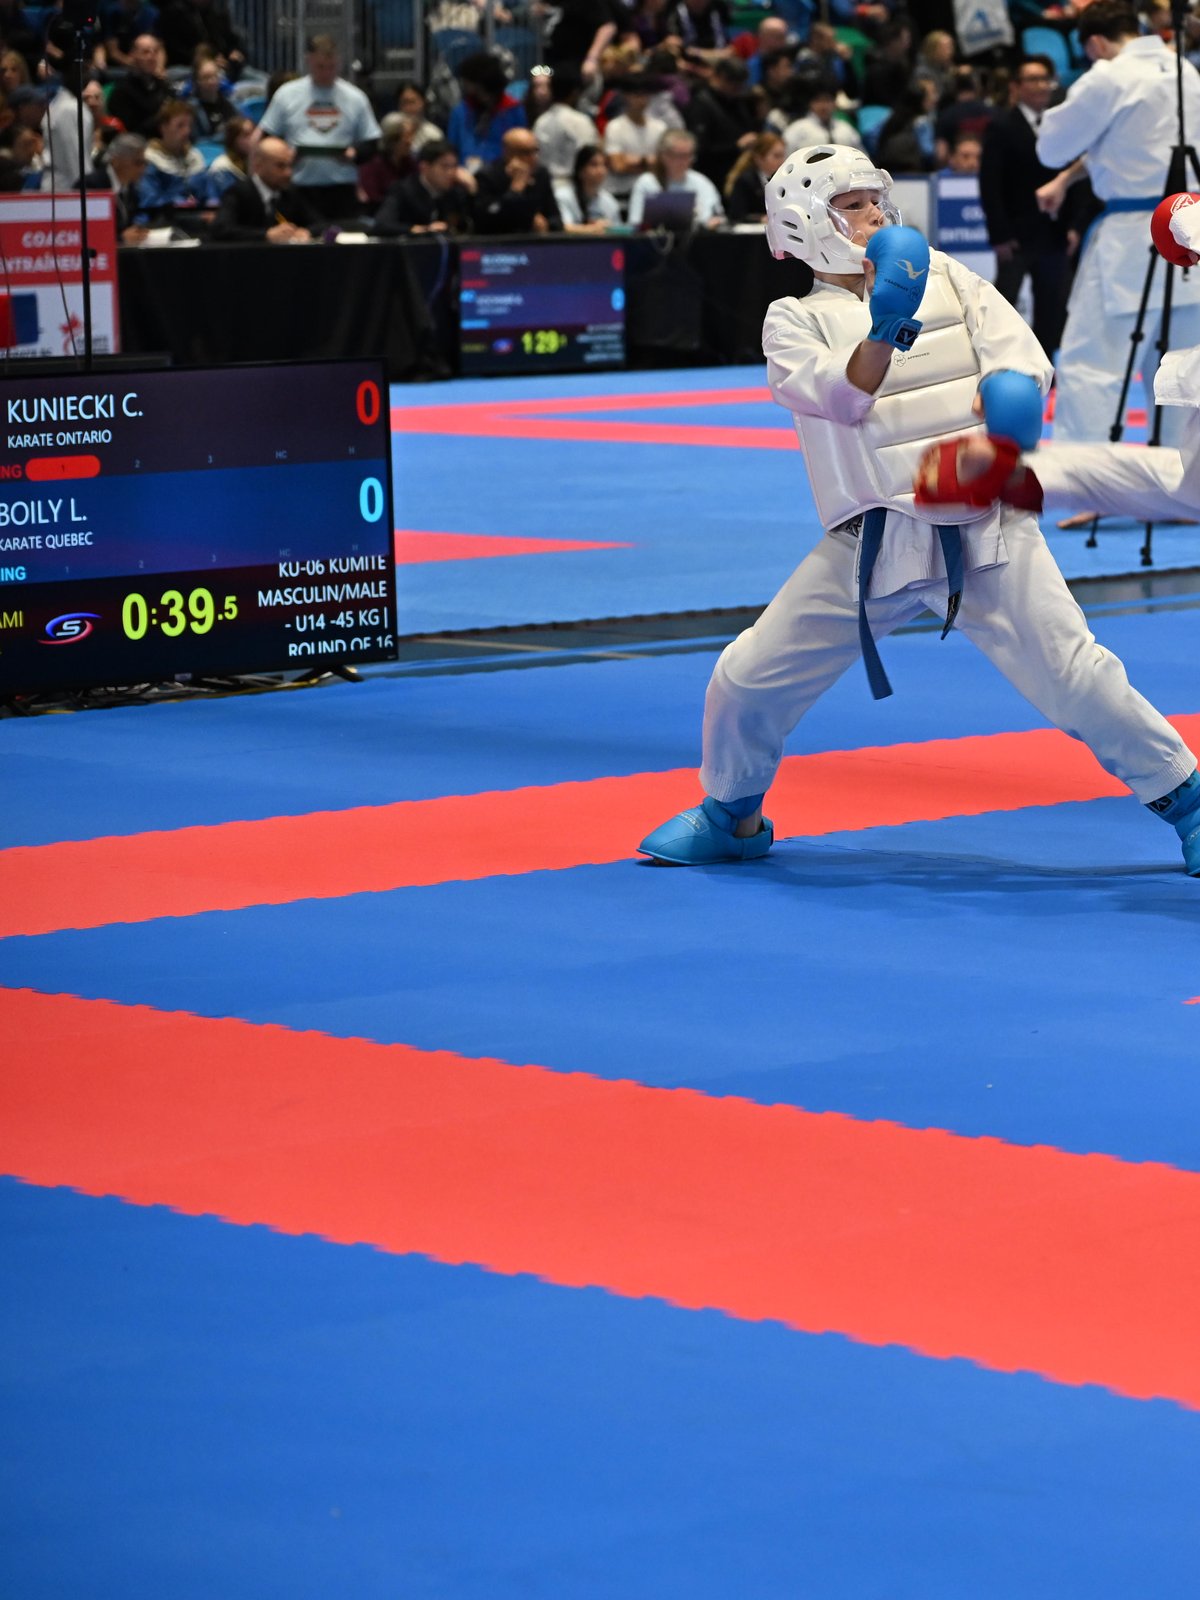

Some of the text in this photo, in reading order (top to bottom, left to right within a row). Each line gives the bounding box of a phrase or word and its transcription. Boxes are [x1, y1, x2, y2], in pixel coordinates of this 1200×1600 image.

[7, 392, 144, 424] KUNIECKI C.
[356, 380, 381, 425] 0
[7, 429, 112, 449] KARATE ONTARIO
[70, 497, 88, 522] L.
[359, 477, 384, 523] 0
[45, 531, 94, 550] QUEBEC
[278, 560, 325, 578] KU-06
[258, 581, 388, 607] MASCULIN/MALE
[0, 609, 24, 630] MI
[295, 612, 326, 633] U14
[330, 609, 355, 629] -45
[358, 607, 380, 627] KG
